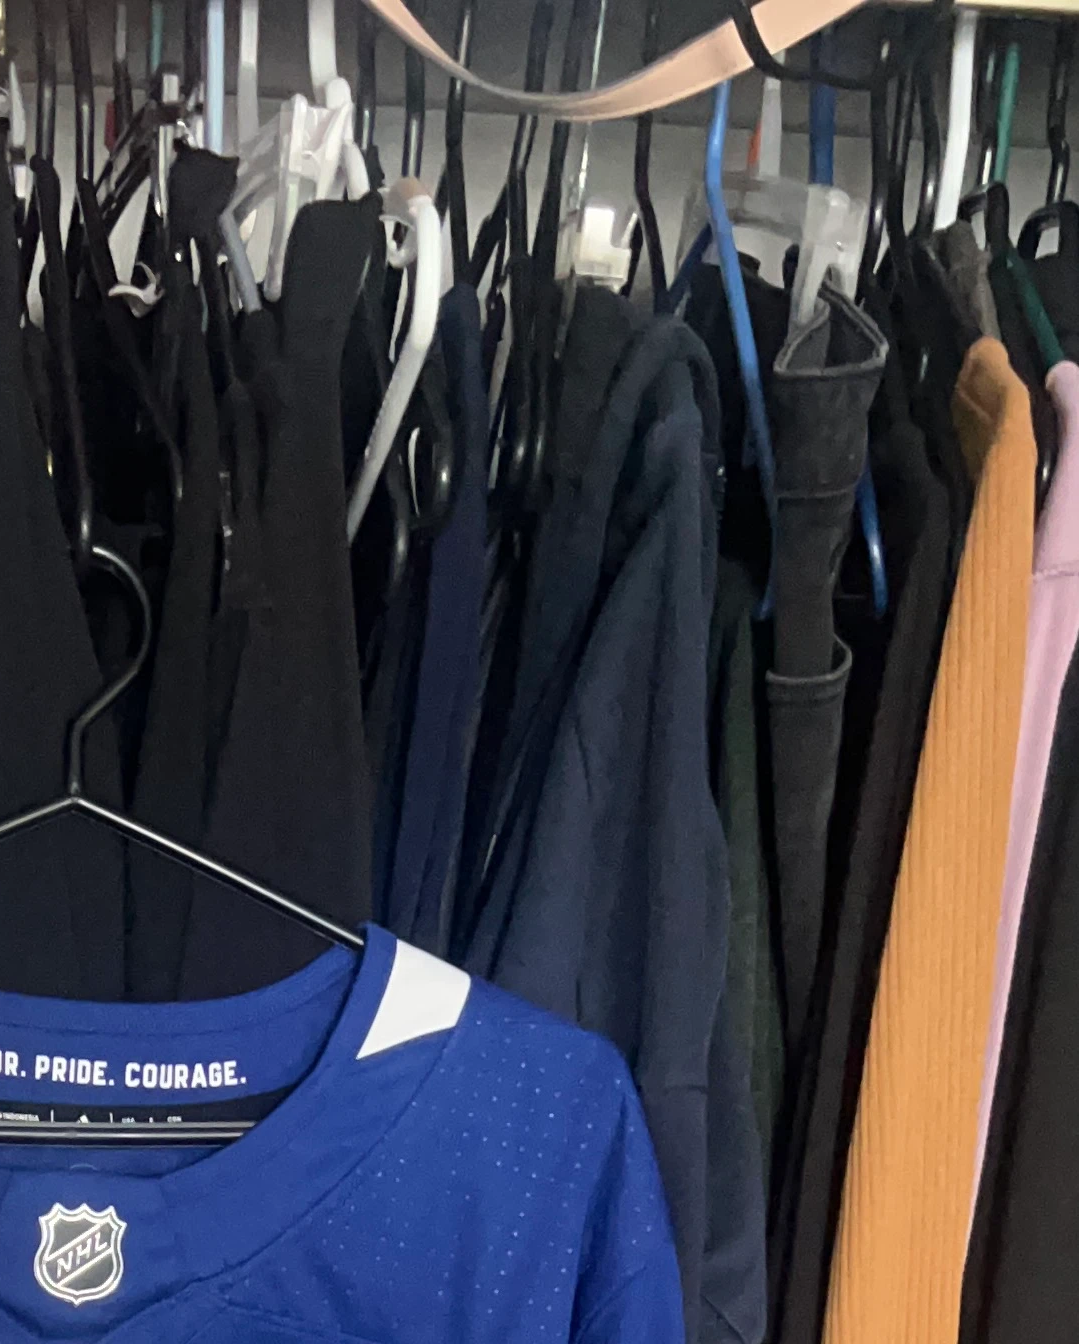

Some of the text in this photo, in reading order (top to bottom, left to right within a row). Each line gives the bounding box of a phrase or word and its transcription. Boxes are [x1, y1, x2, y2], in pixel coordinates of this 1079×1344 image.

[34, 1054, 115, 1086] PRIDE.
[124, 1059, 247, 1089] COURAGE.
[56, 1231, 108, 1279] NHL
